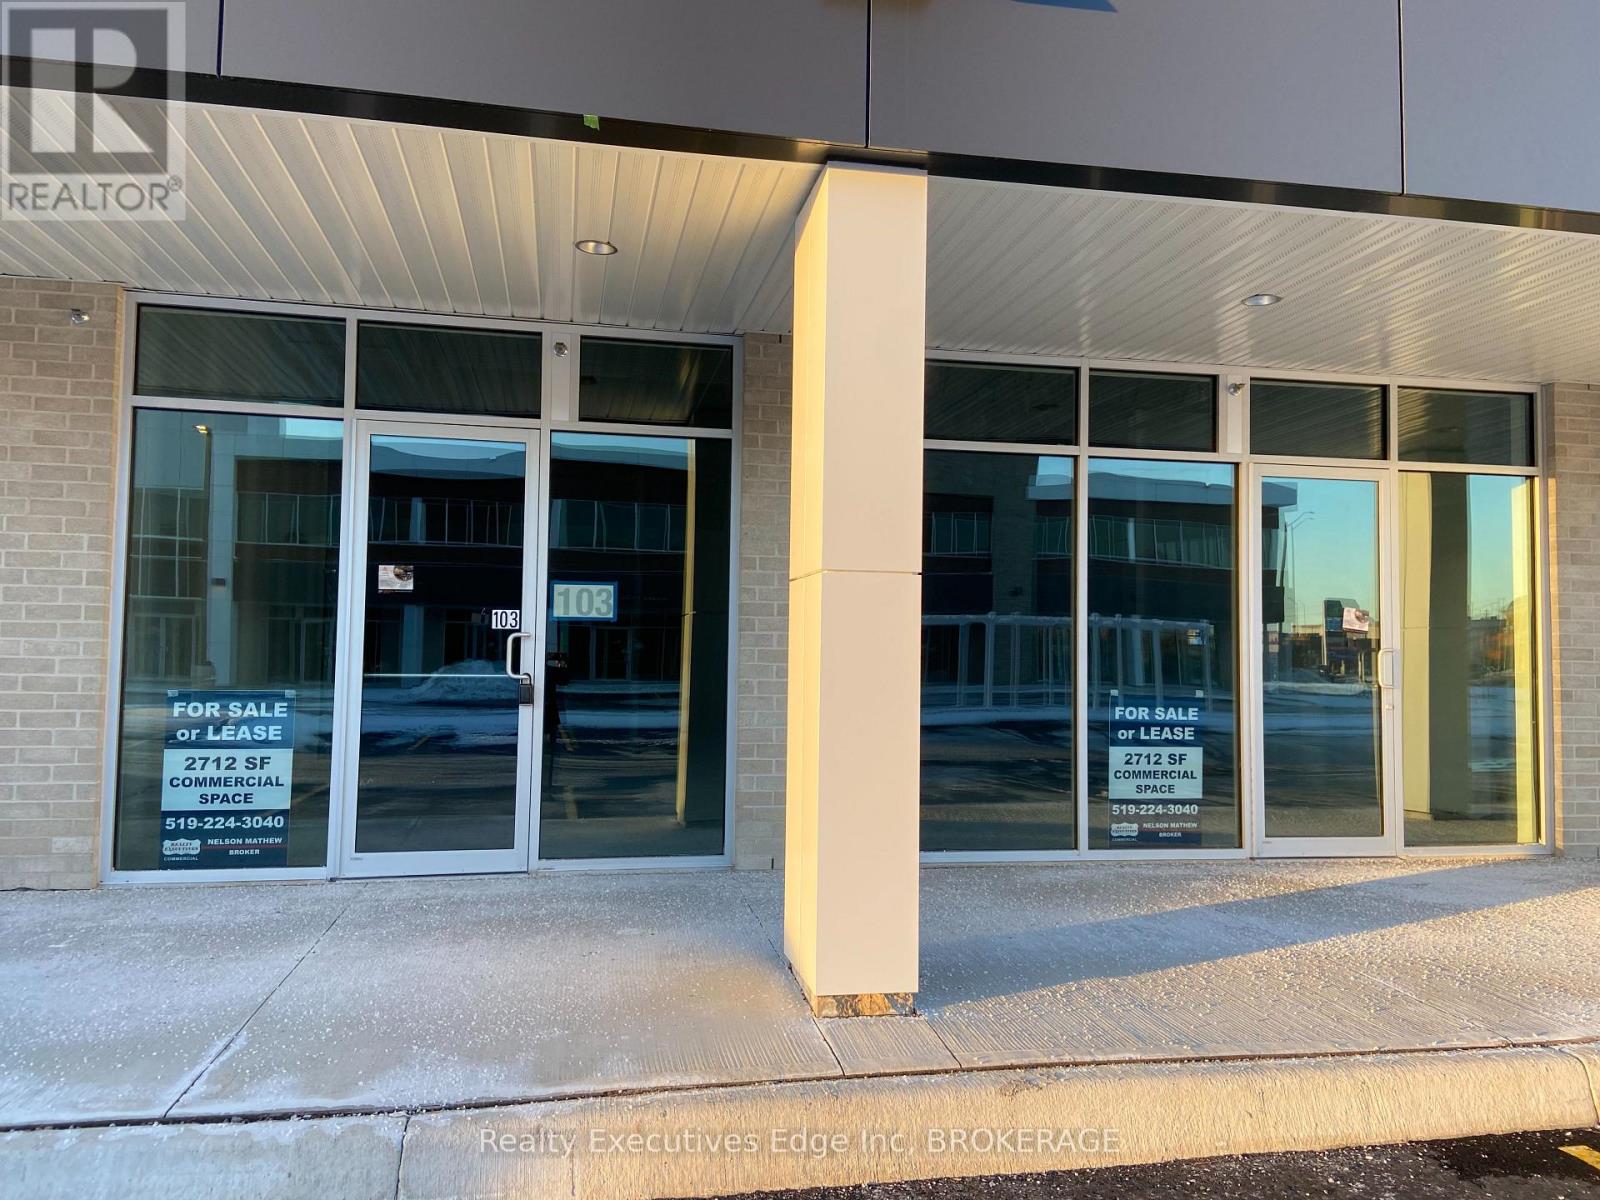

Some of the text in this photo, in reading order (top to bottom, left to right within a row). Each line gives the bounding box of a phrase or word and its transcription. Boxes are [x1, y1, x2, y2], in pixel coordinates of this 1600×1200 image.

[557, 587, 613, 616] 103
[493, 610, 519, 628] 103
[173, 702, 288, 718] FOR SALE
[1114, 707, 1199, 720] FOR SALE
[176, 725, 282, 740] or LEASE
[1117, 726, 1195, 740] or LEASE
[184, 756, 271, 771] 2712 SF
[1124, 753, 1187, 766] 2712 SF
[1114, 769, 1197, 779] COMMERCIAL
[169, 775, 284, 788] COMMERCIAL
[1135, 784, 1175, 794] SPACE
[198, 793, 254, 804] SPACE
[1112, 804, 1199, 815] 519-224-3040
[165, 816, 285, 830] 519-224-3040
[207, 837, 282, 846] NELSON MATHEW
